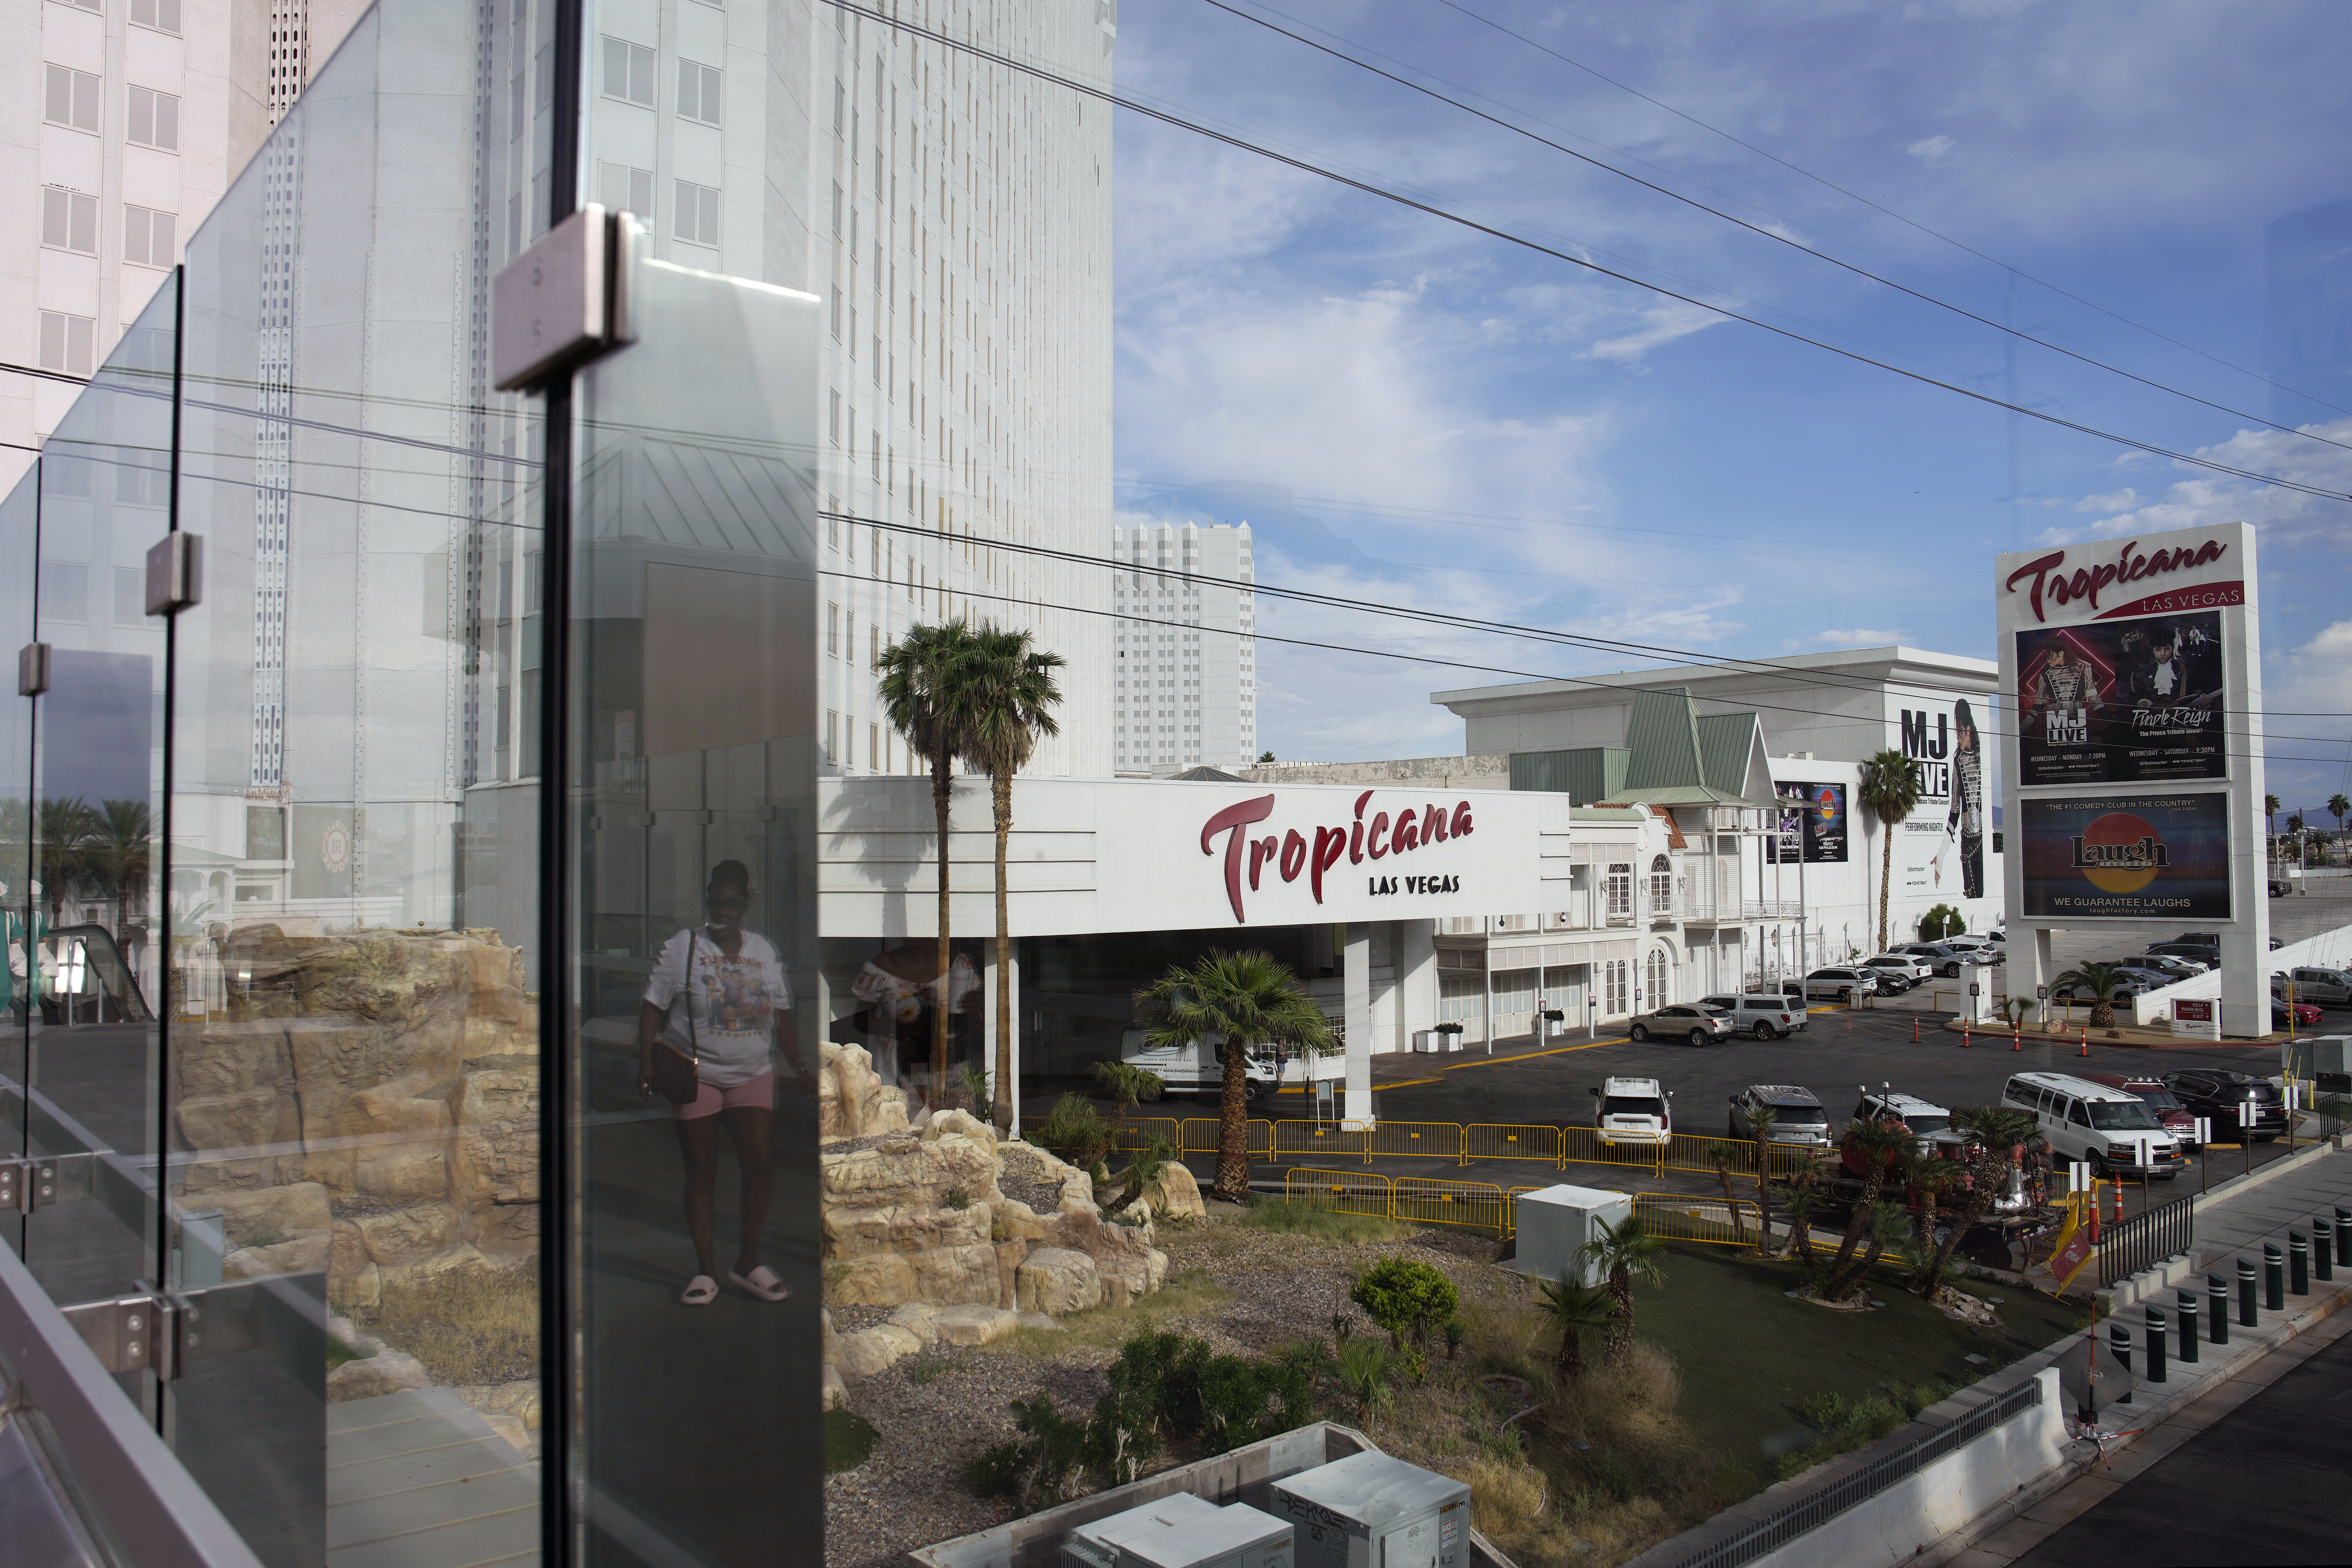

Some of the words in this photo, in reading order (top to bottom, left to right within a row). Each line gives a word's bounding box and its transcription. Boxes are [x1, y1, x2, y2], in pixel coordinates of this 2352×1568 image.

[2006, 540, 2227, 622] Tropicana
[2143, 597, 2172, 612] LAS
[2179, 590, 2239, 607] VEGAS
[2046, 708, 2087, 729] MJ
[2132, 708, 2170, 731] Purple
[2171, 707, 2211, 727] Reign
[1901, 709, 1947, 760] MJ
[2048, 728, 2085, 743] LIVE
[1818, 798, 1836, 811] Laugh
[1814, 822, 1827, 834] LIVE!
[1905, 822, 1928, 831] PERFORMING
[1929, 822, 1943, 831] NIGHTLY
[1201, 790, 1474, 924] Tropicana
[2070, 836, 2170, 869] Laugh
[1369, 874, 1398, 896] LAS
[1405, 874, 1459, 895] VEGAS
[2054, 897, 2071, 906] WE
[2074, 898, 2141, 906] GUARANTEE
[2143, 898, 2190, 907] LAUGHS
